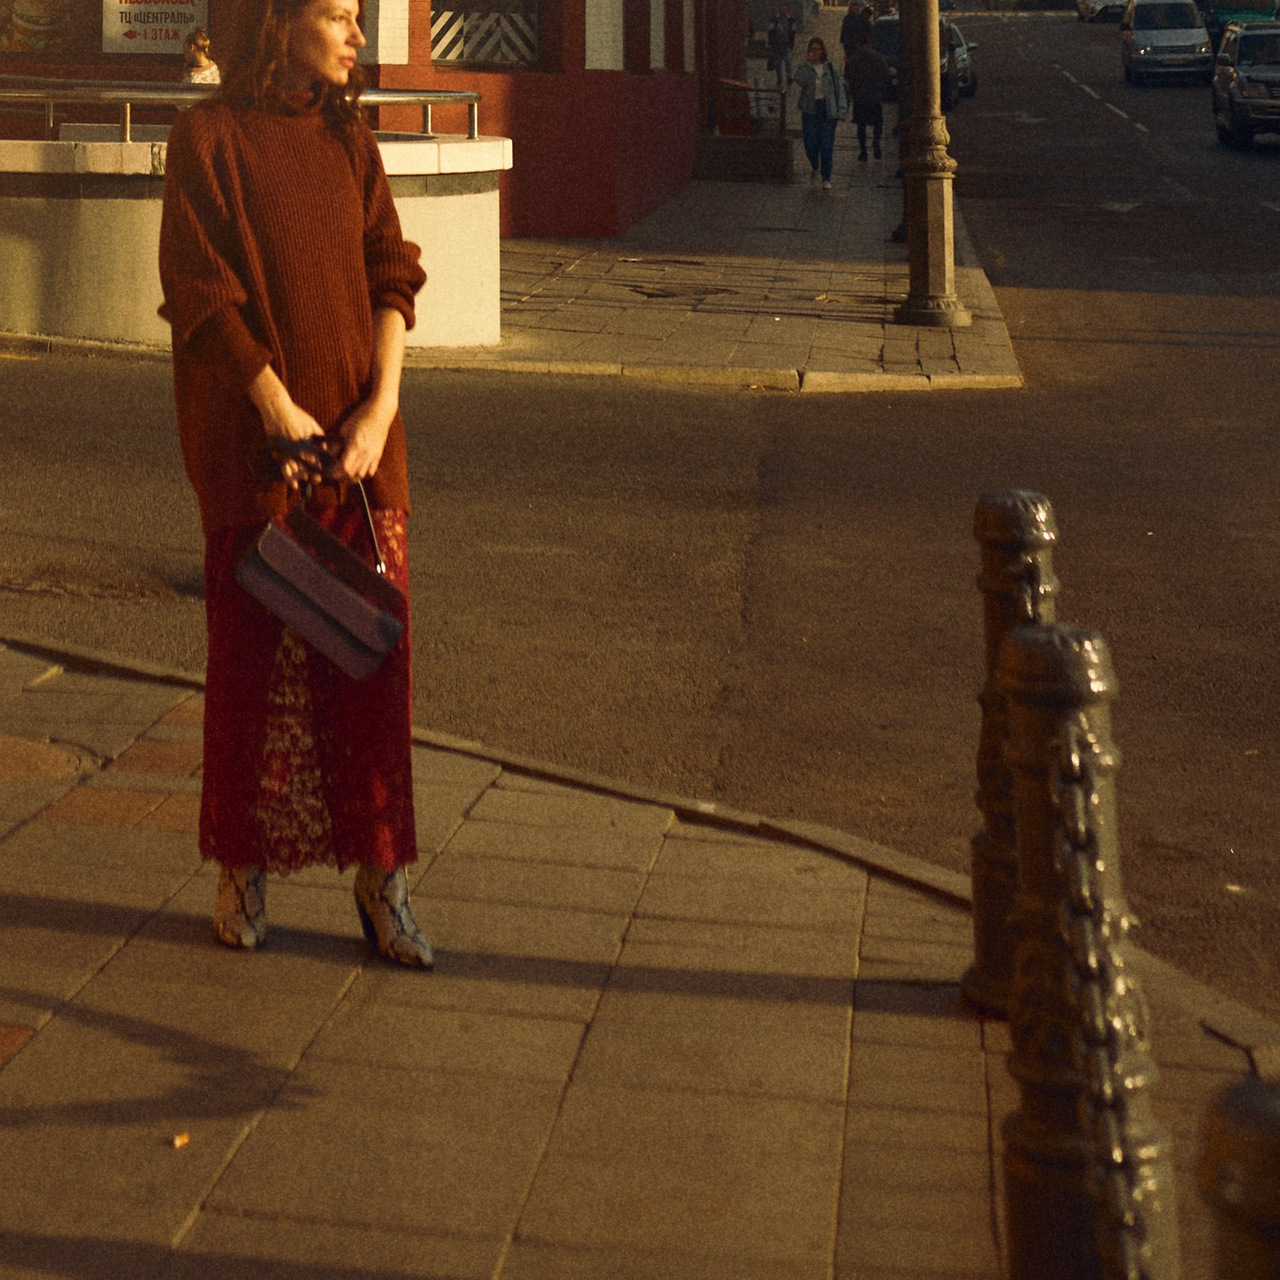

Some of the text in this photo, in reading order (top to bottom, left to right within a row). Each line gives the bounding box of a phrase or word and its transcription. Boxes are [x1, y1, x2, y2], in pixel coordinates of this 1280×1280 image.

[119, 11, 195, 25] ТЦ «ЦЕНТРАЛЬ»
[143, 28, 181, 41] 1 ЭТАЖ
